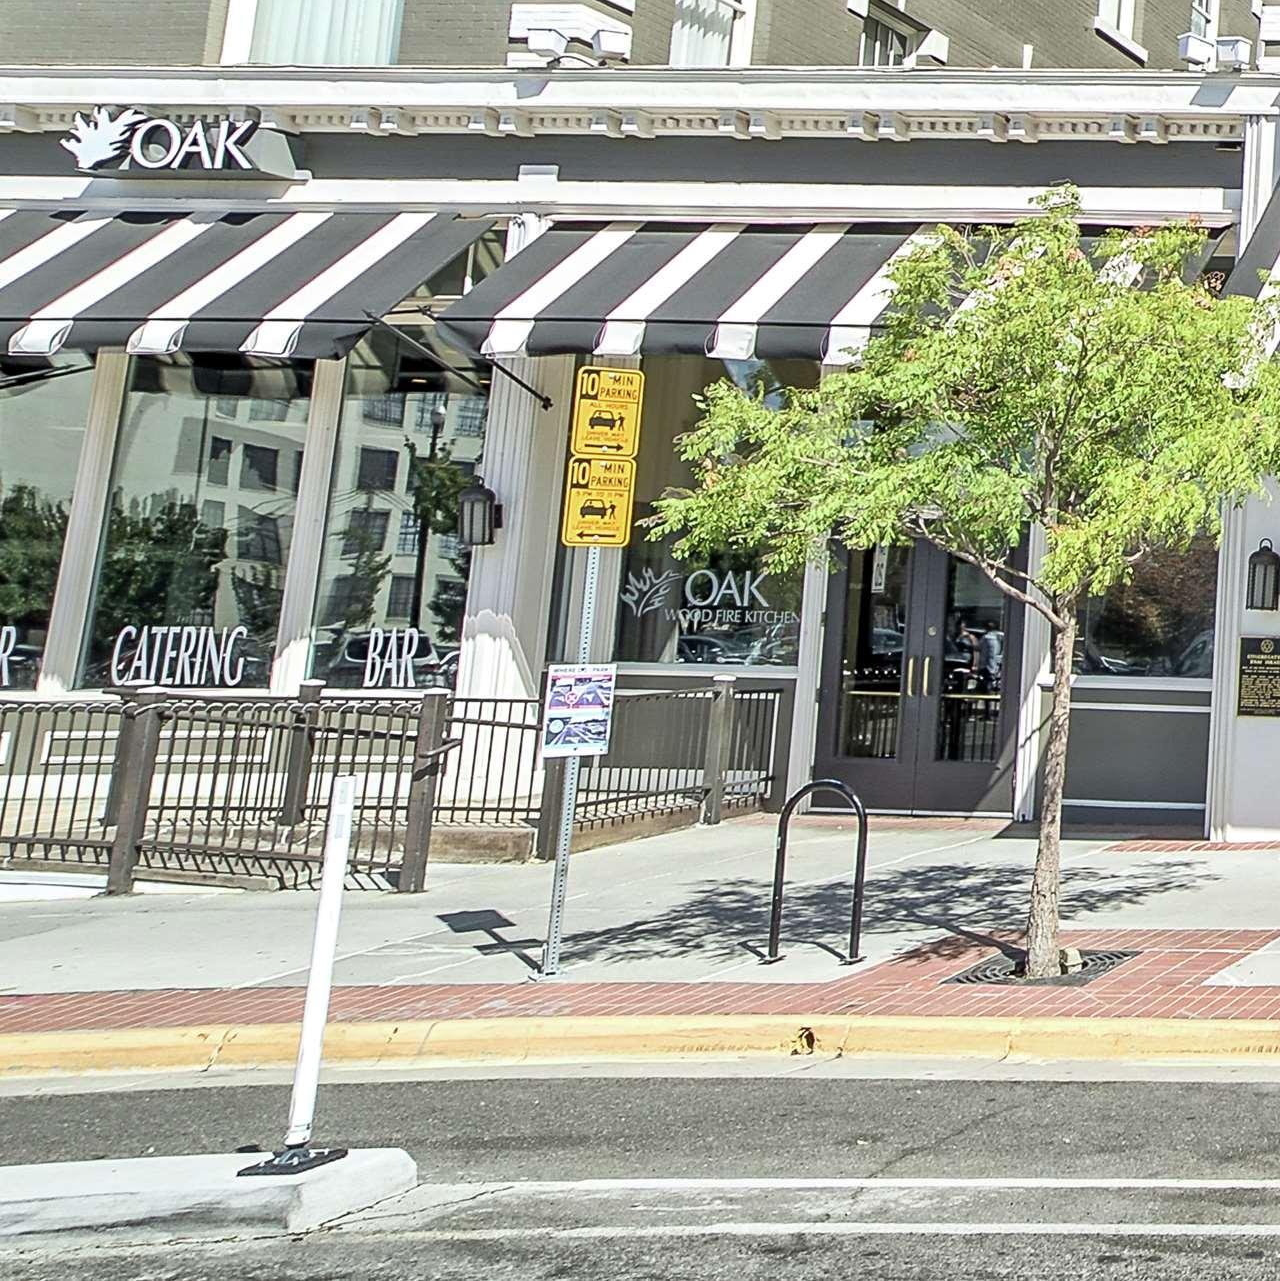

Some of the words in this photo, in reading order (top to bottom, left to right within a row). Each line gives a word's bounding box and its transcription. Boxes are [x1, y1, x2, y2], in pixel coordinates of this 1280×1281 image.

[131, 118, 254, 170] OAK
[581, 372, 600, 395] 10
[612, 375, 634, 386] MIN
[599, 387, 638, 400] PARKING
[572, 461, 590, 485] 10
[603, 464, 625, 474] MIN
[590, 476, 629, 488] PARKING
[684, 569, 770, 607] OAK
[664, 608, 713, 623] WOOD
[716, 609, 742, 623] FIRE
[745, 610, 801, 625] KITCHEN
[111, 624, 248, 686] CATERING
[363, 627, 420, 688] BAR
